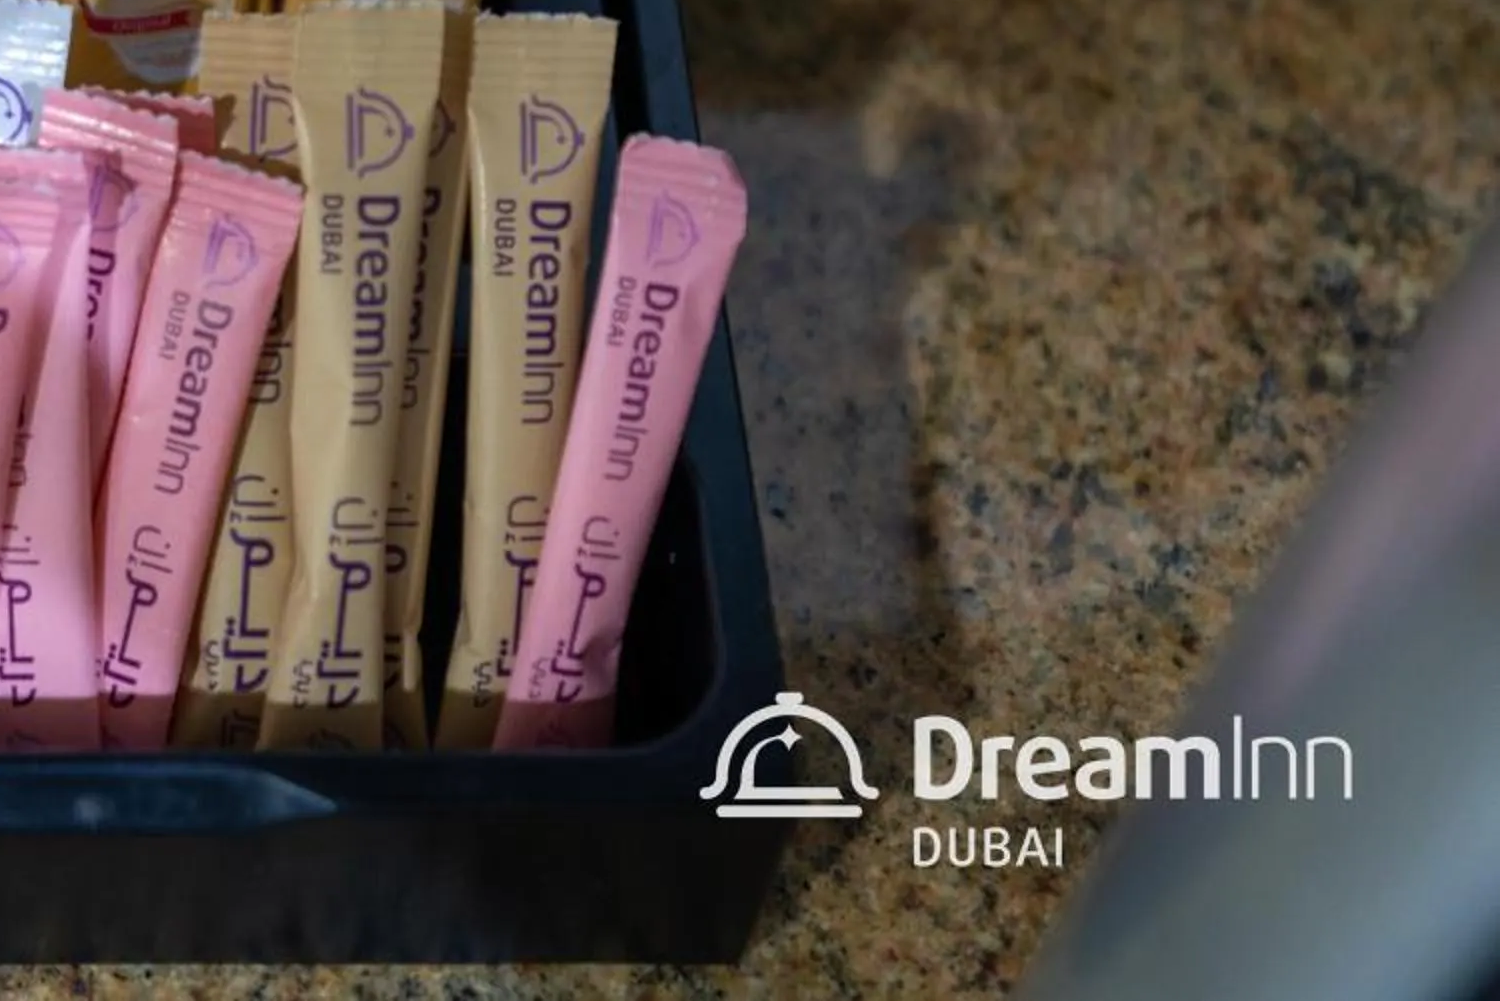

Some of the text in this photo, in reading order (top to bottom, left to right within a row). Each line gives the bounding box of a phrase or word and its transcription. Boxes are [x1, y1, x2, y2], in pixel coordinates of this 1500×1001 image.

[319, 194, 344, 276] DUBAI
[491, 199, 517, 278] DUBAI
[159, 291, 191, 361] DUBAI
[350, 195, 401, 427] DreamInn
[520, 200, 573, 426] DreamInn
[606, 276, 638, 348] DUBAI
[155, 299, 234, 497] DreamInn
[604, 283, 680, 482] DreamInn
